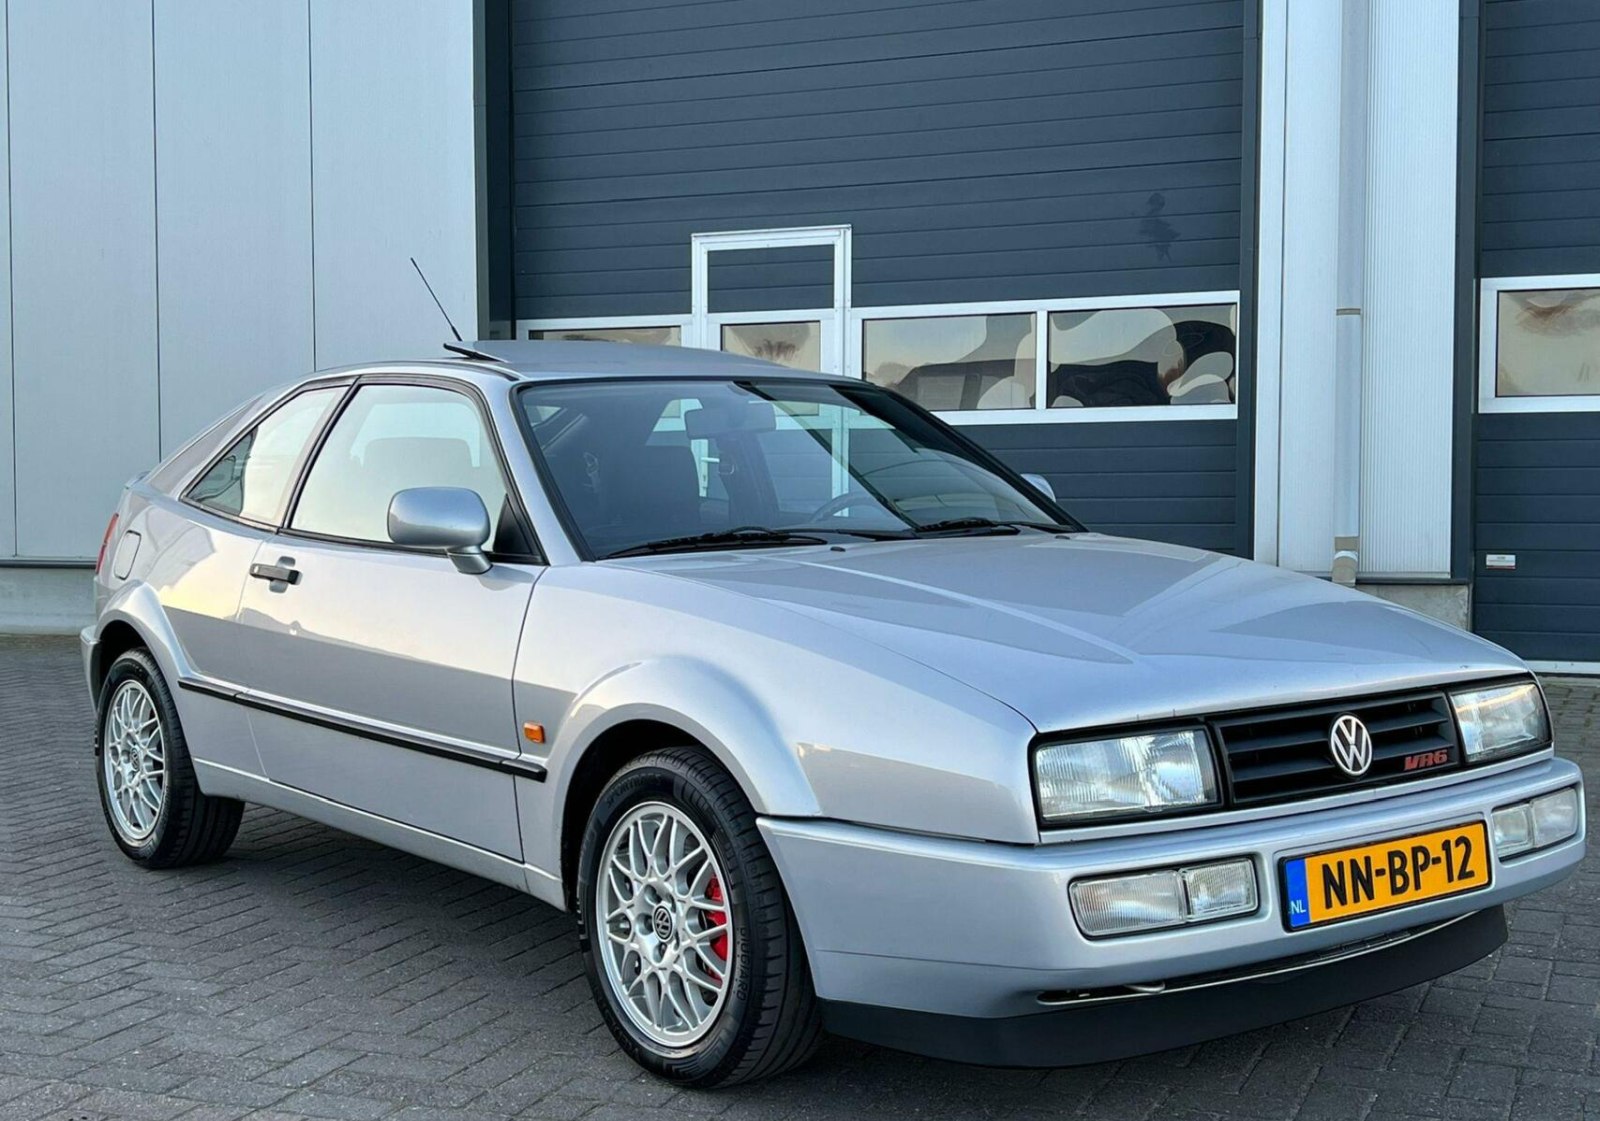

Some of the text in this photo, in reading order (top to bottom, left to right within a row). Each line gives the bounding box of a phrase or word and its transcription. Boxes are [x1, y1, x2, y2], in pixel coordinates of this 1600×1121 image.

[1331, 715, 1372, 775] VW
[1404, 749, 1448, 771] VR6
[1321, 835, 1475, 909] NN-BP-12
[1290, 900, 1306, 914] NL
